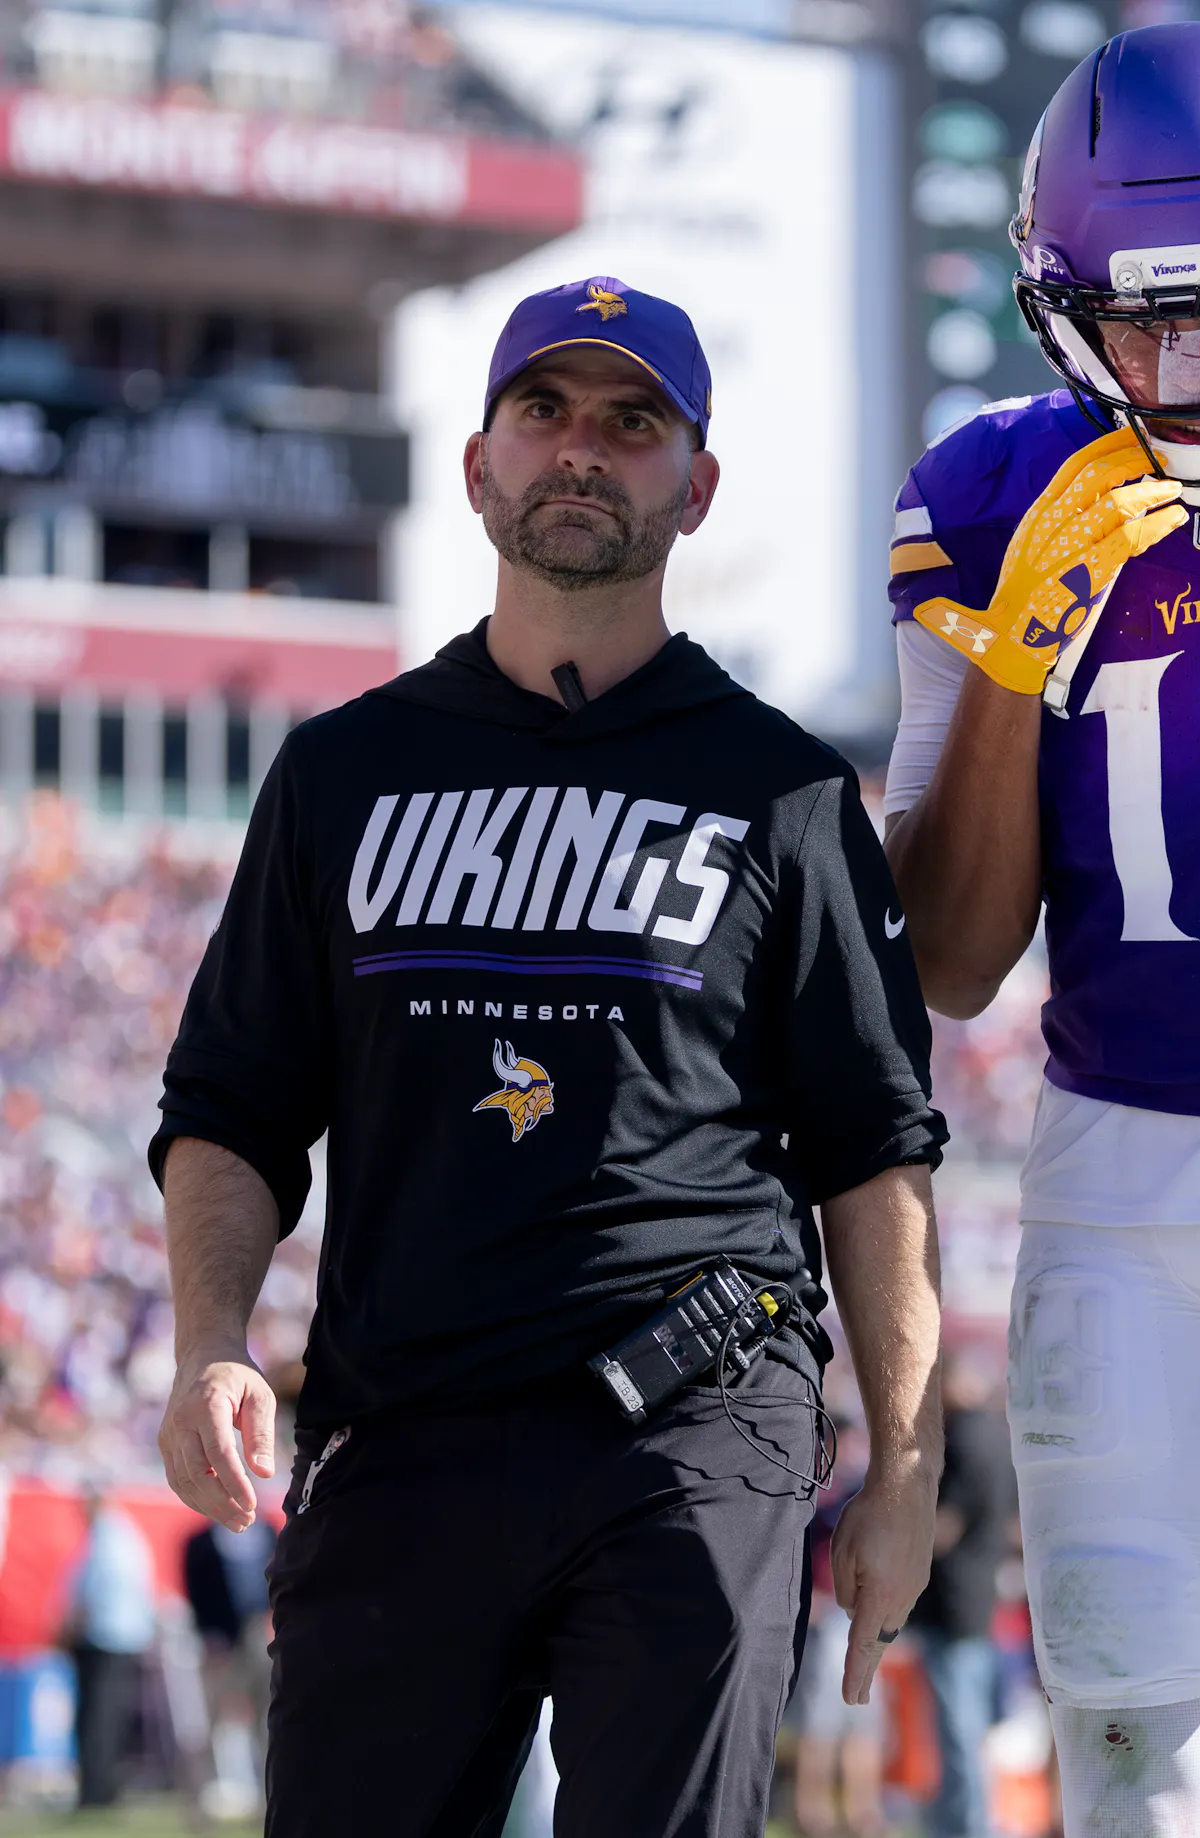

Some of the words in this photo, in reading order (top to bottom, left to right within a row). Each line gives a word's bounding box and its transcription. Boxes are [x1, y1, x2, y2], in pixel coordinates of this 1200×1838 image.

[1026, 626, 1045, 643] UA
[347, 786, 751, 946] VIKINGS
[410, 999, 625, 1022] MINNESOTA
[627, 1395, 640, 1410] 23
